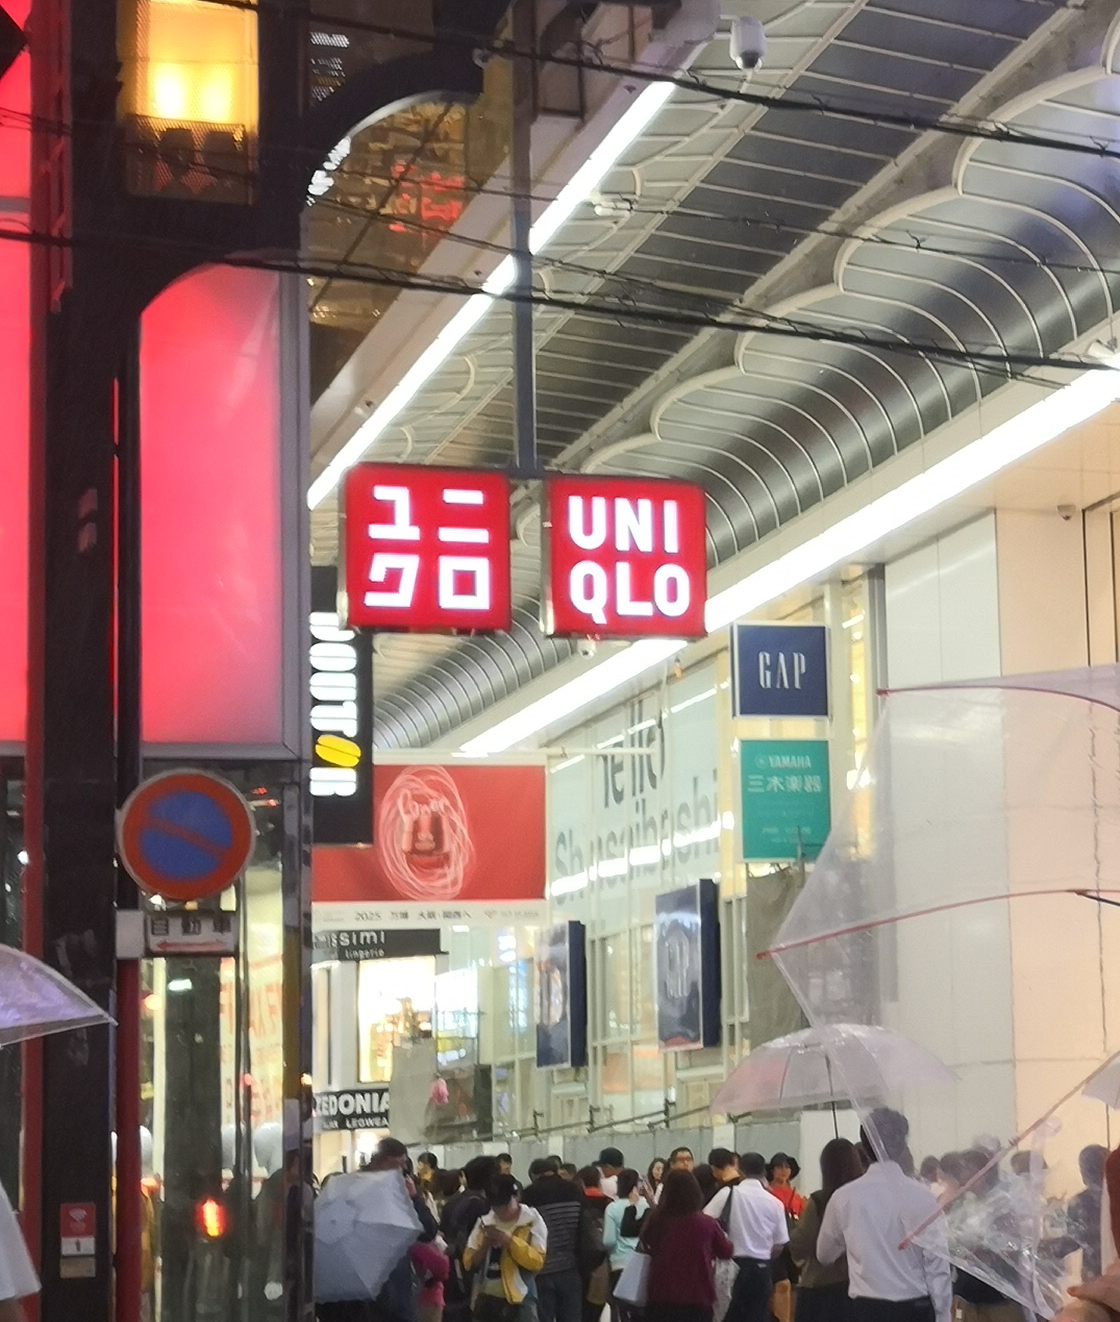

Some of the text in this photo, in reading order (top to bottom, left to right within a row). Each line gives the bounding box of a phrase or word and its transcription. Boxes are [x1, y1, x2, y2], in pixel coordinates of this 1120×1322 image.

[368, 485, 490, 544] ユニ
[567, 495, 678, 554] UNI
[363, 552, 490, 610] クロ
[569, 560, 691, 624] QLO
[758, 651, 806, 691] GAP
[768, 755, 812, 769] YAMAHA
[315, 1092, 390, 1116] ZEDONIA
